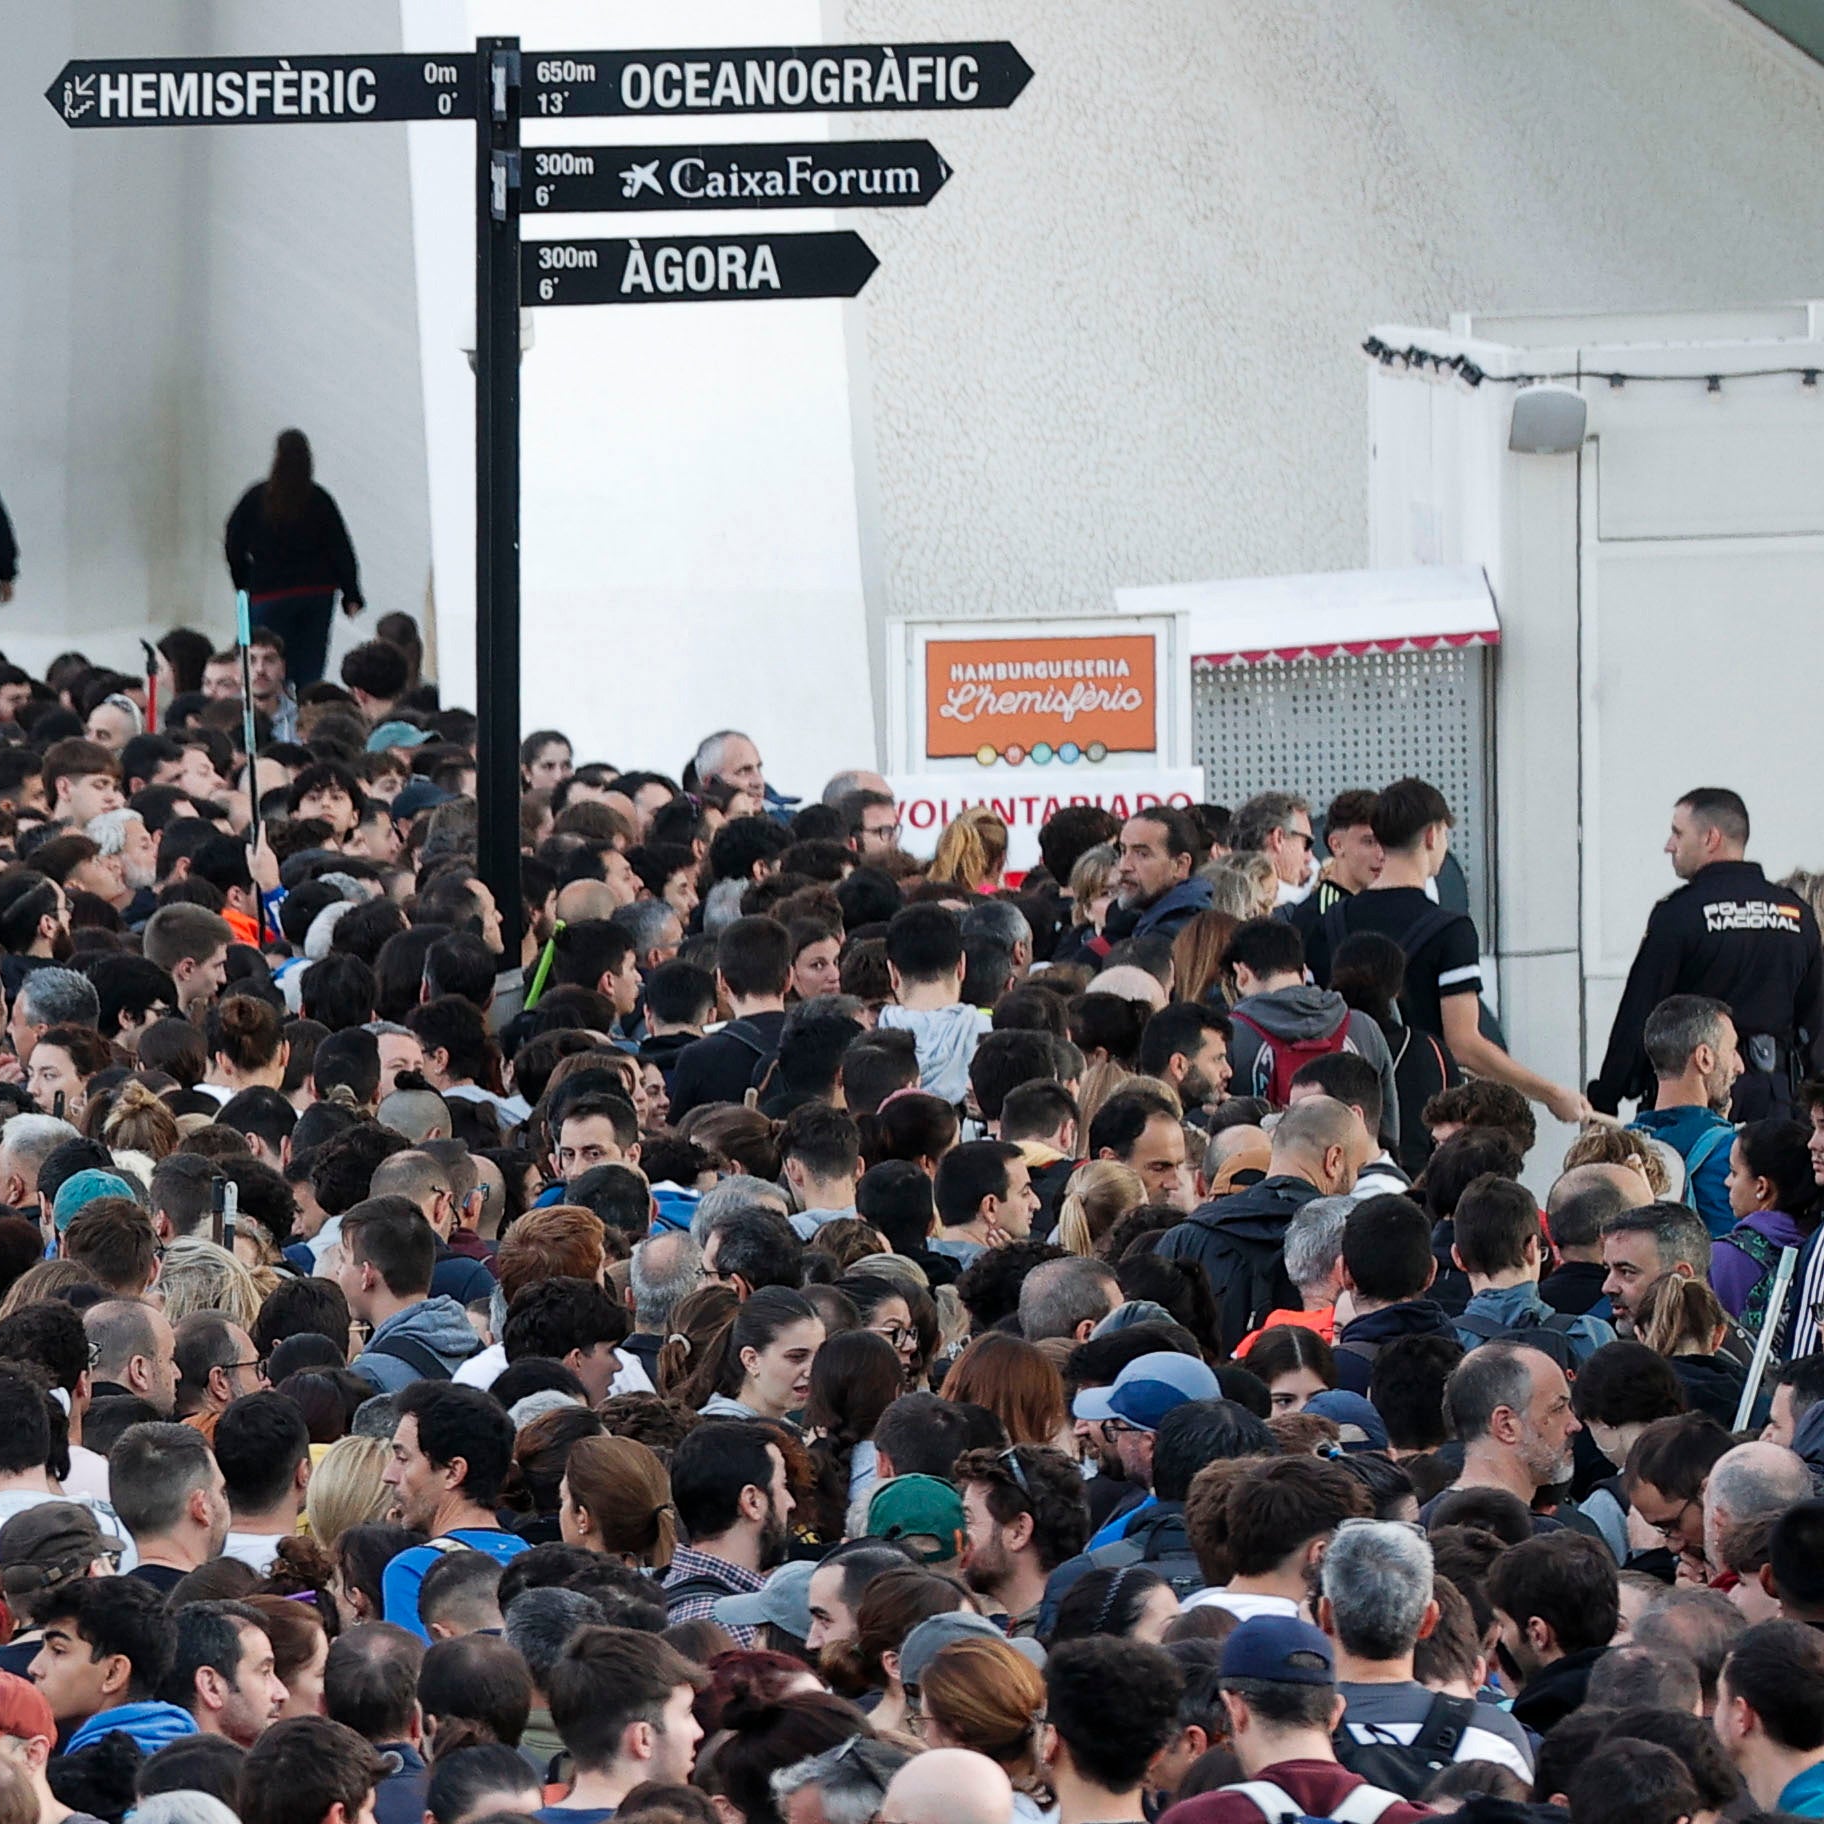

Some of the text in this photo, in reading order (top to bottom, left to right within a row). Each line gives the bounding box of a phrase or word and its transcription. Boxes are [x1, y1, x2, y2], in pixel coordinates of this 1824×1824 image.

[424, 62, 457, 84] 0m
[536, 60, 596, 83] 650m
[620, 46, 980, 108] OCEANOGRÀFIC
[100, 58, 377, 118] HEMISFÈRIC
[535, 153, 594, 175] 300m
[671, 157, 921, 198] CaixaForum
[538, 246, 598, 269] 300m
[620, 236, 781, 293] ÀGORA
[951, 657, 1129, 681] HAMBURGUESERIA
[1703, 900, 1780, 919] POLICIA
[1707, 914, 1801, 933] NACIONAL
